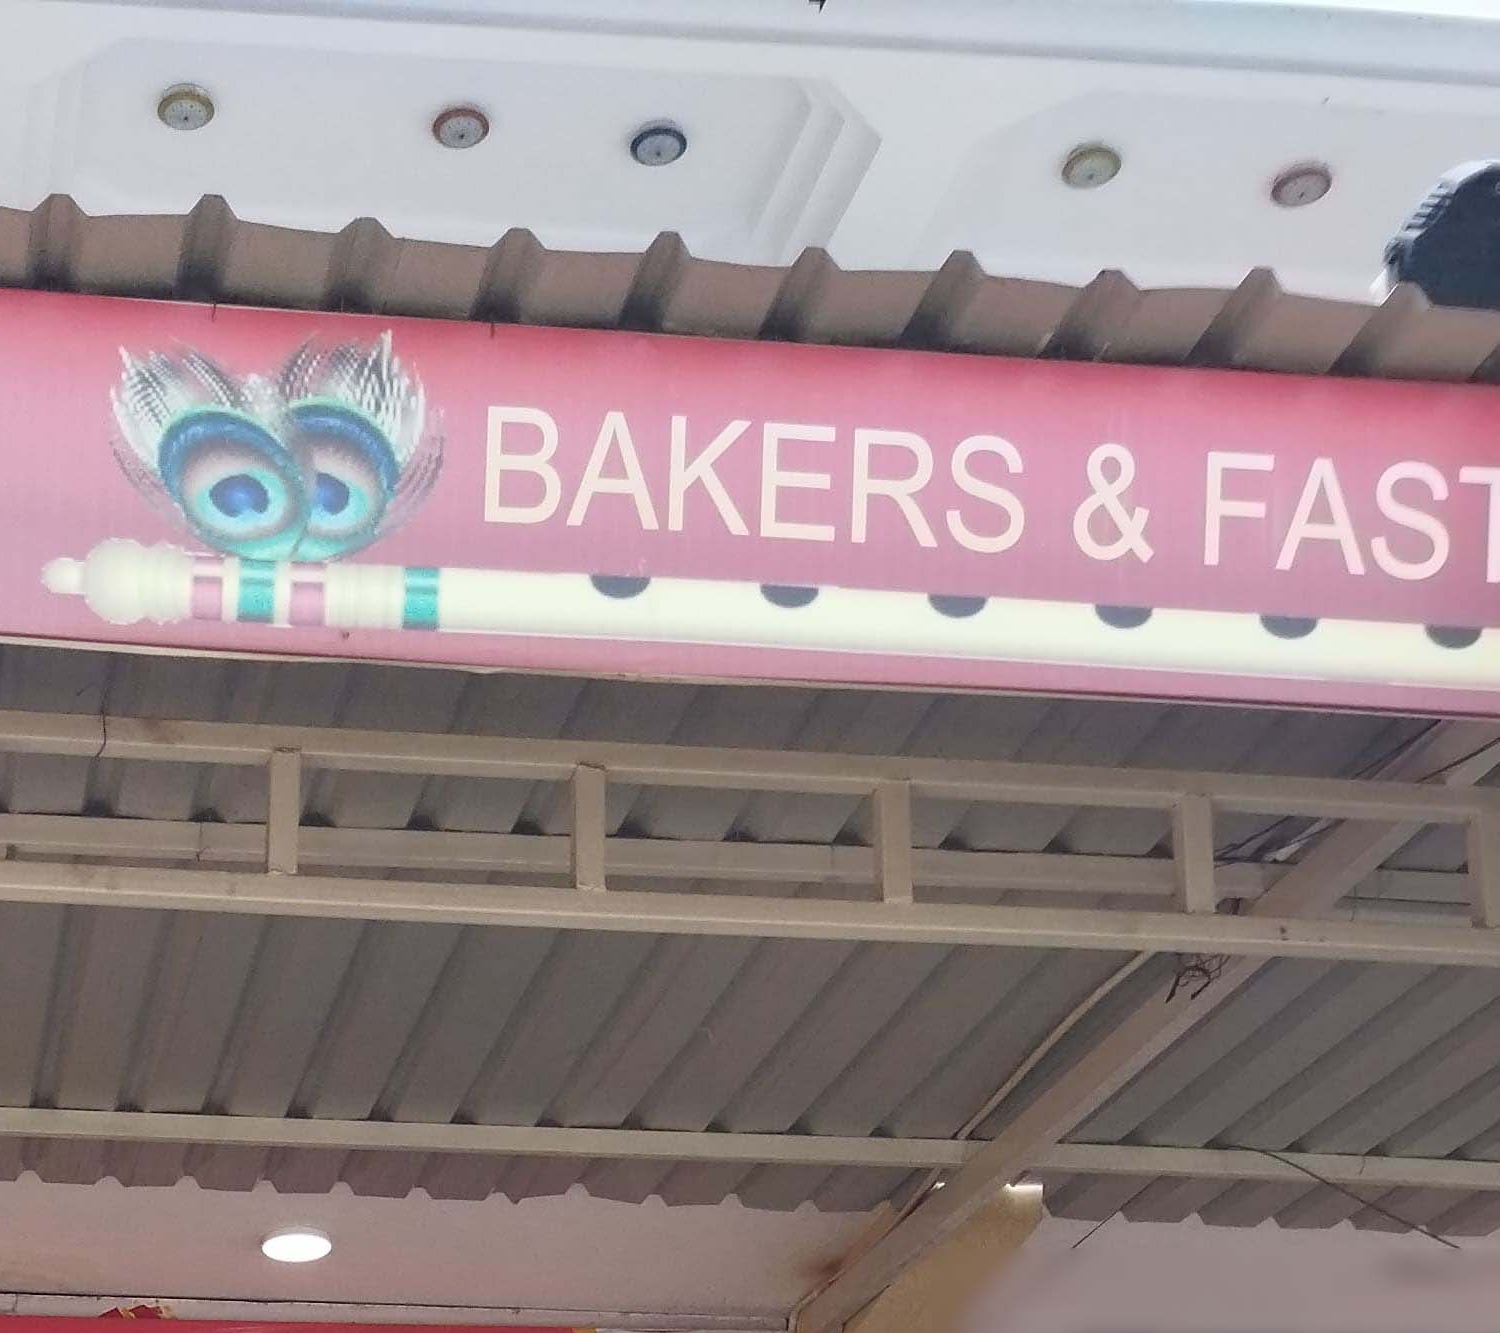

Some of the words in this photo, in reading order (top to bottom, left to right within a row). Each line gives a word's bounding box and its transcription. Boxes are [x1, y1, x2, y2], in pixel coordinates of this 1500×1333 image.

[483, 405, 1026, 554] BAKERS
[1072, 443, 1155, 564] &
[1203, 451, 1500, 583] FAST
